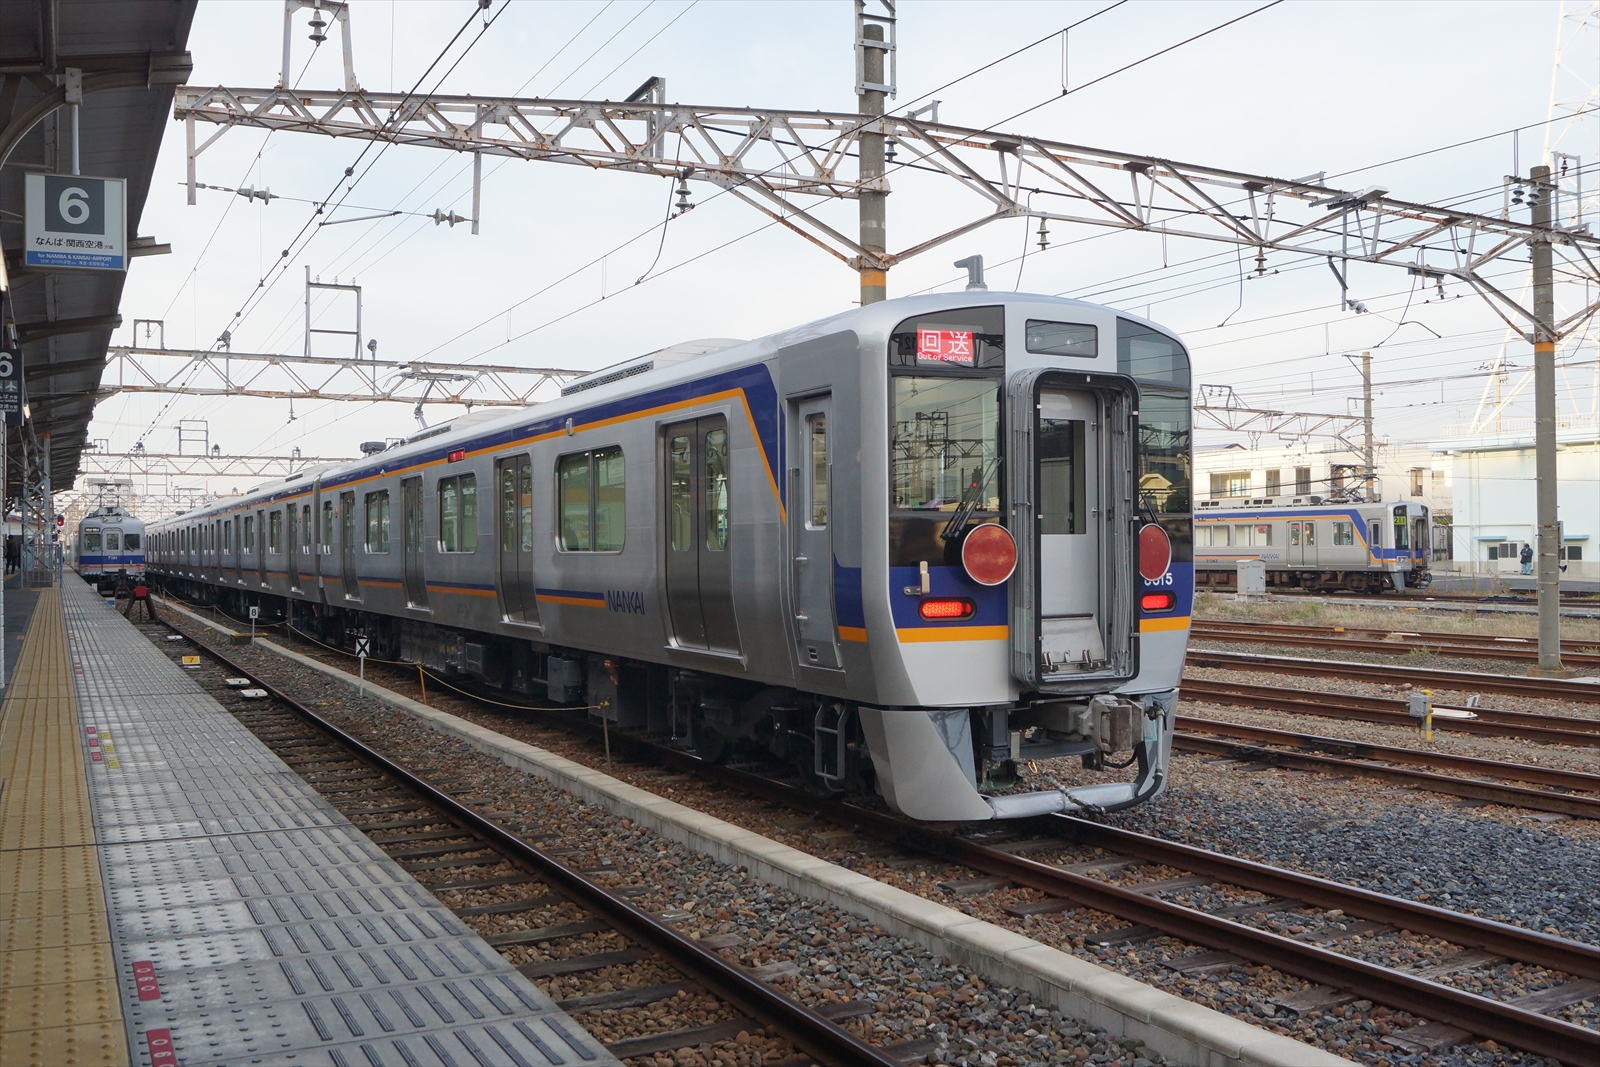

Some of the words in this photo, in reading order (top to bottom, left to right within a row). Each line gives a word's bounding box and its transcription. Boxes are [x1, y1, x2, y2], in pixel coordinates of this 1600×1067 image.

[59, 187, 90, 224] 6
[921, 329, 970, 355] 回送
[0, 352, 13, 377] 6
[943, 354, 972, 362] Service
[251, 608, 257, 616] 8
[608, 590, 645, 615] NANKAI
